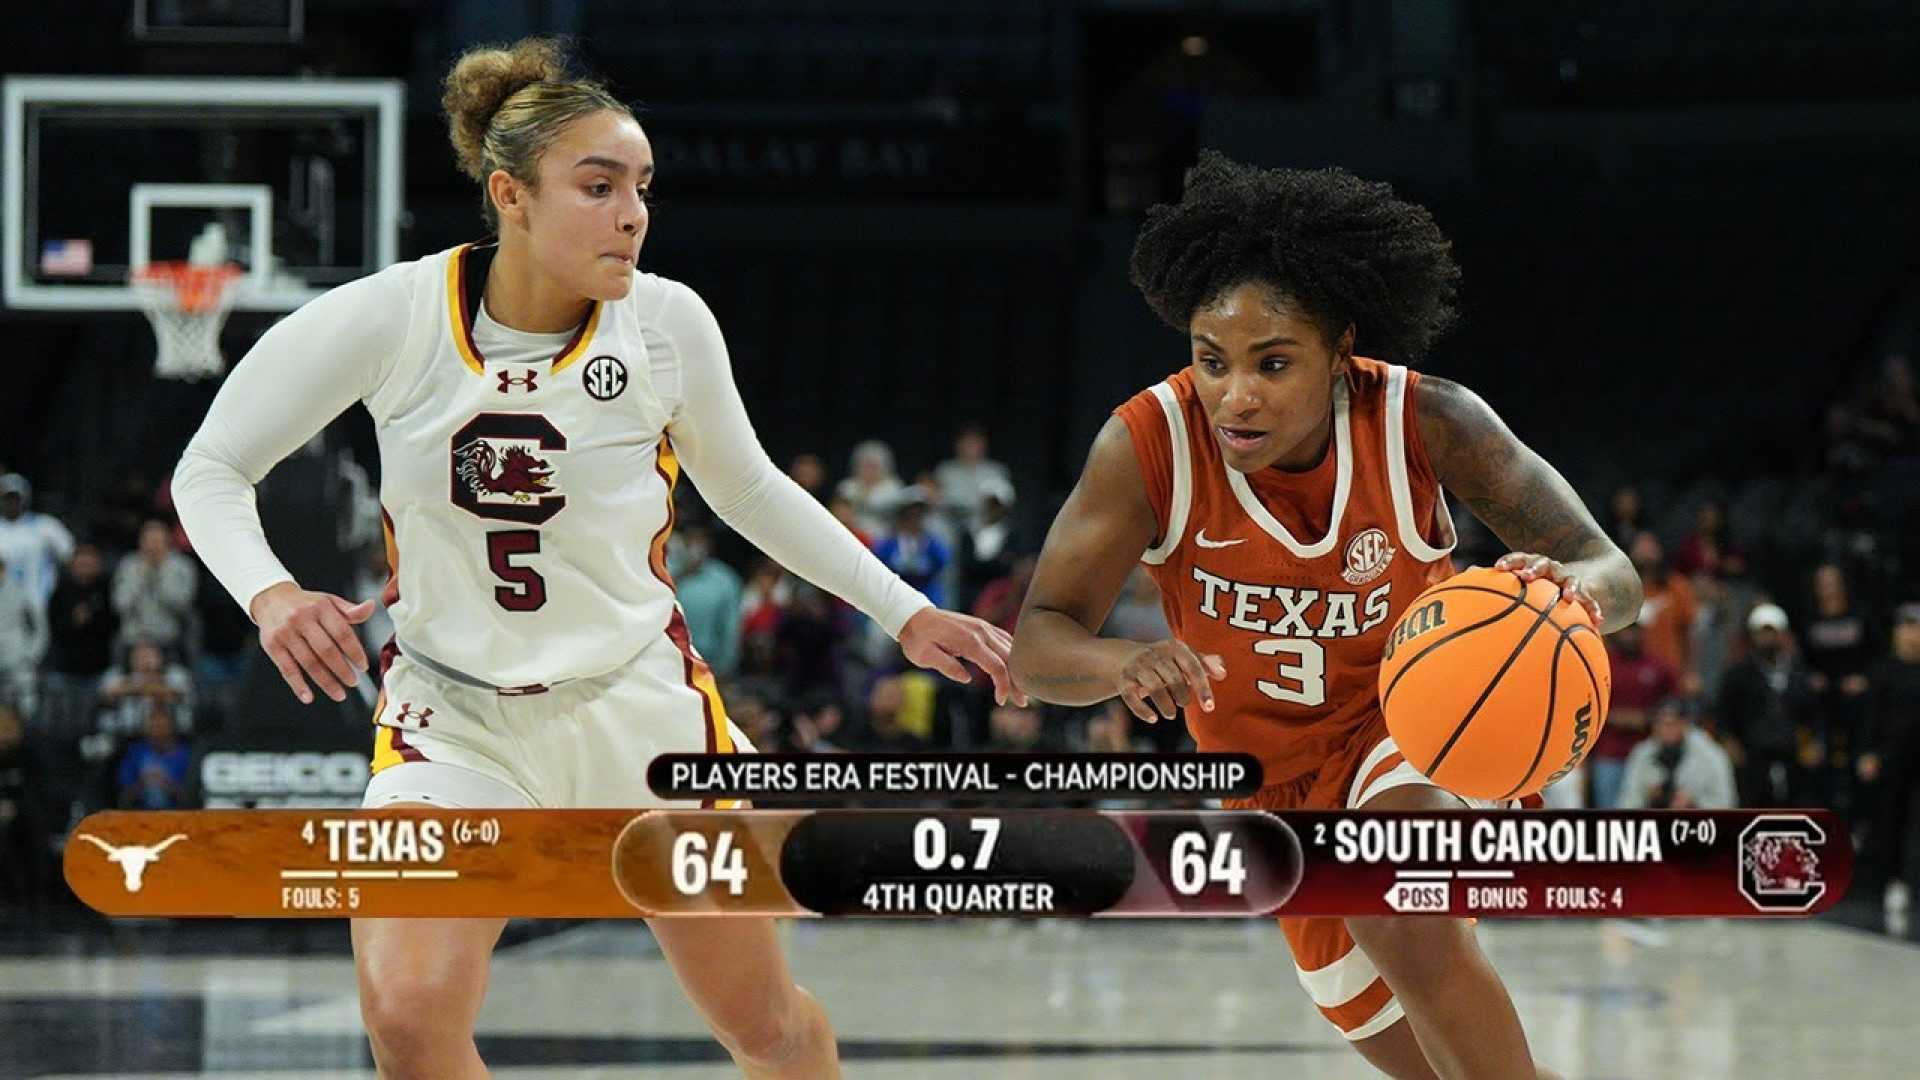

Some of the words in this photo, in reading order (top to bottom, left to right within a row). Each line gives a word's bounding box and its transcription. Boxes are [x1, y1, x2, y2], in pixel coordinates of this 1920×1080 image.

[587, 358, 624, 398] SEC
[486, 529, 547, 612] 5
[1351, 533, 1384, 571] SEC
[1193, 567, 1392, 637] TEXAS
[1253, 638, 1325, 706] 3
[203, 752, 368, 793] GEICO
